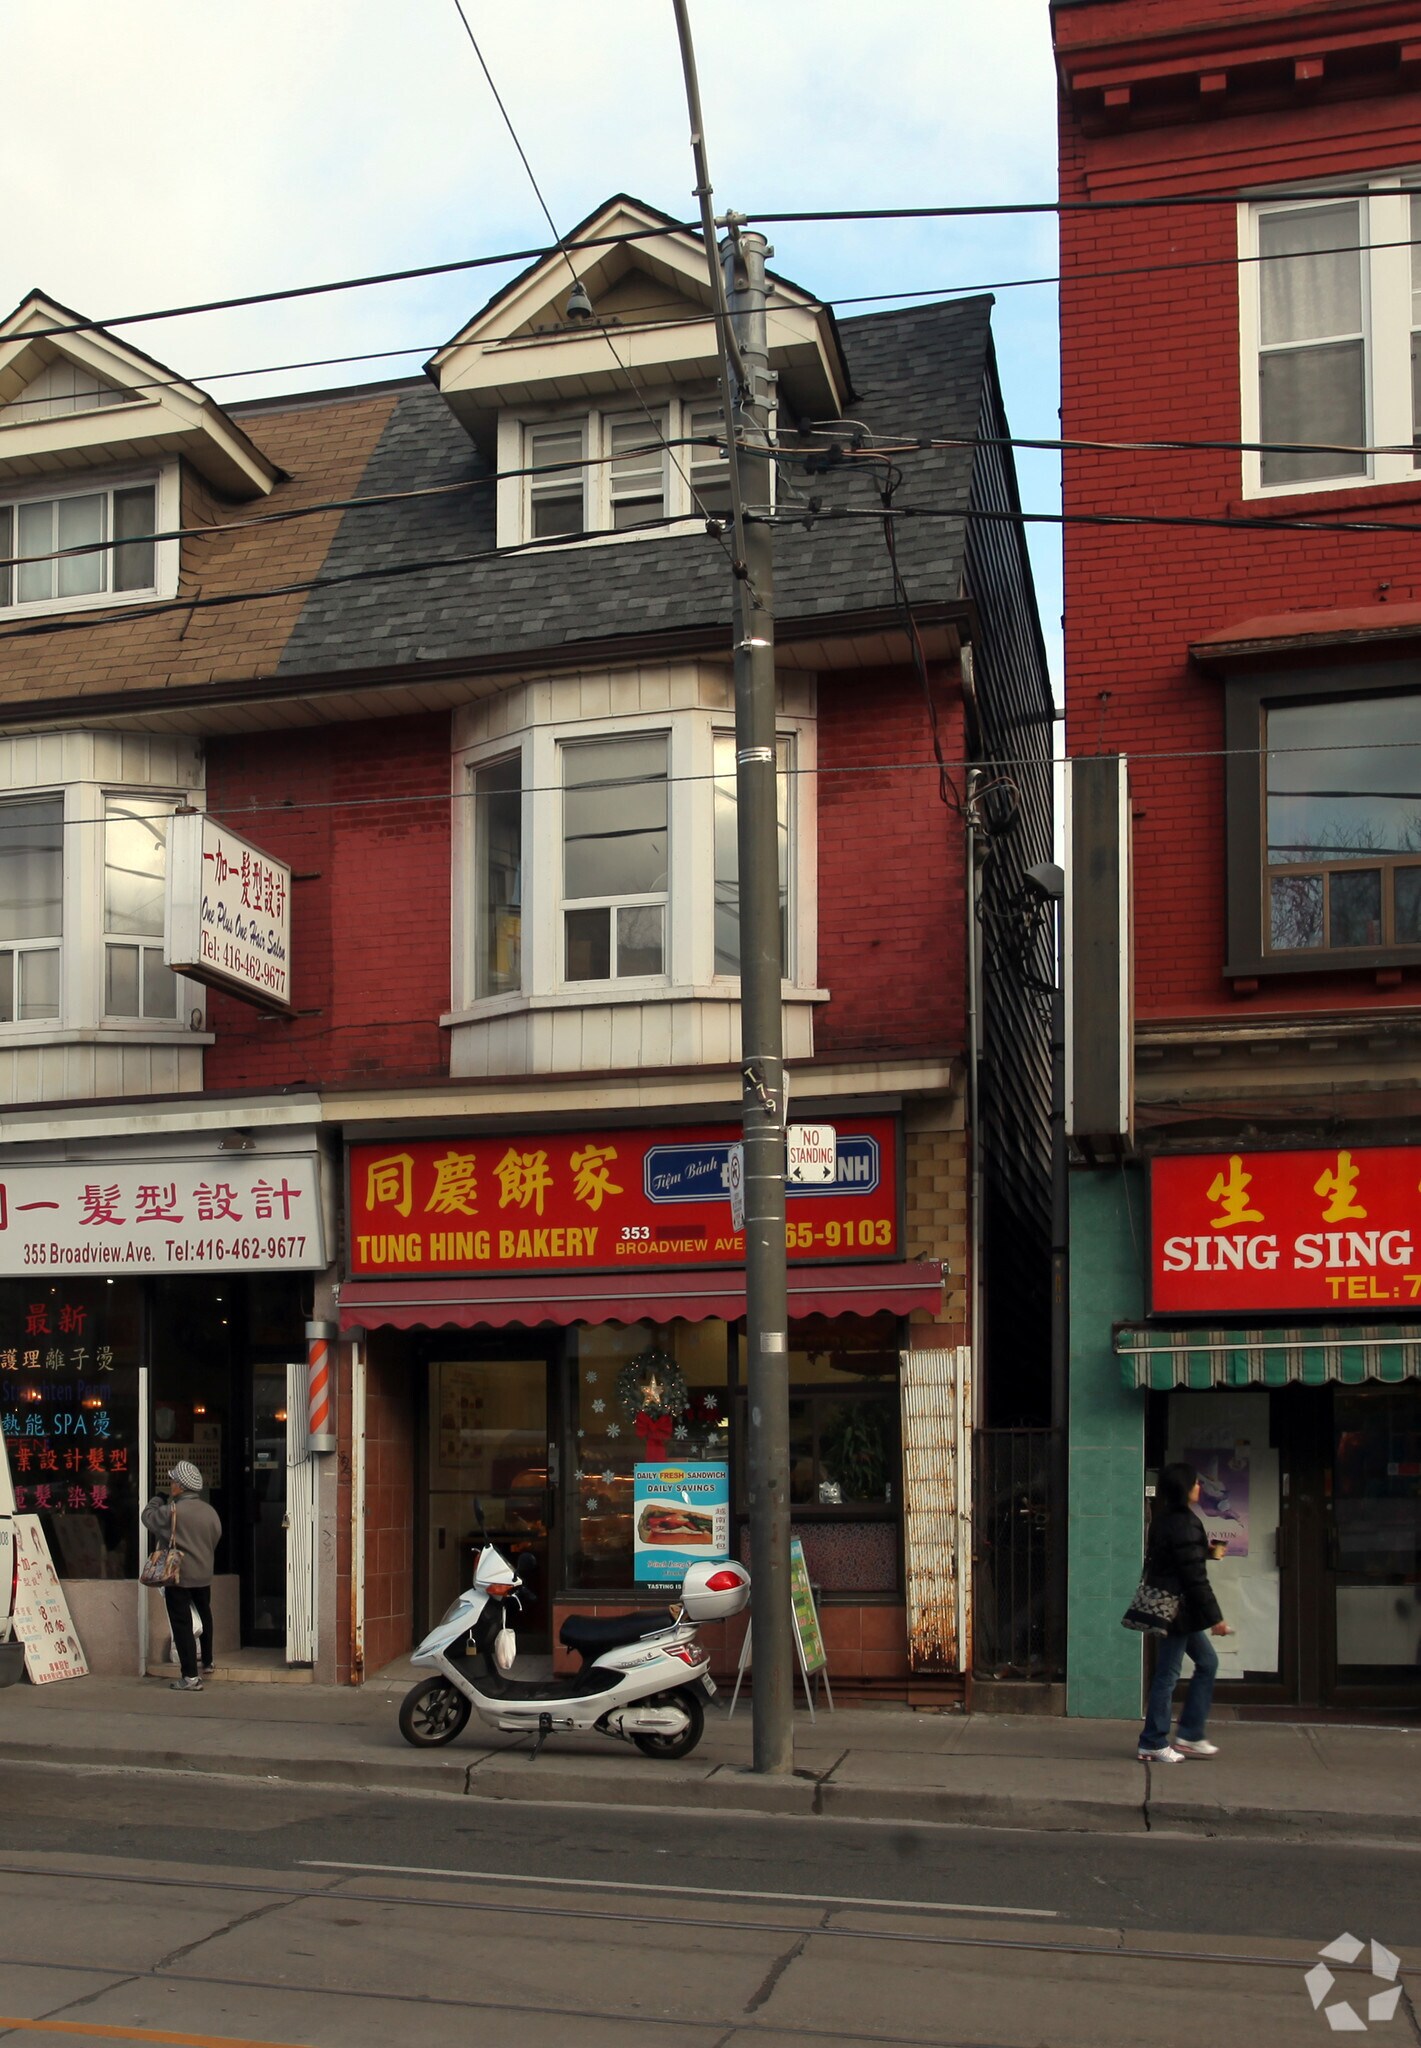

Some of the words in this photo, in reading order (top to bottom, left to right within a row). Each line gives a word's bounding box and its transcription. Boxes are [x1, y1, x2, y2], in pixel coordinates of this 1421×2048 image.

[217, 901, 234, 935] Plus
[202, 930, 221, 964] Tel:
[222, 942, 287, 994] 416-462-9677
[803, 1130, 819, 1146] NO
[790, 1147, 833, 1163] STANDING
[365, 1144, 624, 1217] 同慶餅家
[1206, 1151, 1421, 1229] 生生
[0, 1178, 302, 1230] 一髮型設計
[357, 1233, 422, 1264] TUNG
[430, 1230, 490, 1261] HING
[499, 1227, 599, 1259] BAKERY
[616, 1239, 709, 1255] BROADVIEW
[621, 1226, 650, 1240] 353
[785, 1219, 892, 1249] 65-9103
[1163, 1234, 1280, 1271] SING
[1294, 1230, 1414, 1269] SING
[25, 1303, 88, 1336] 最新
[676, 1484, 715, 1492] SAVINGS
